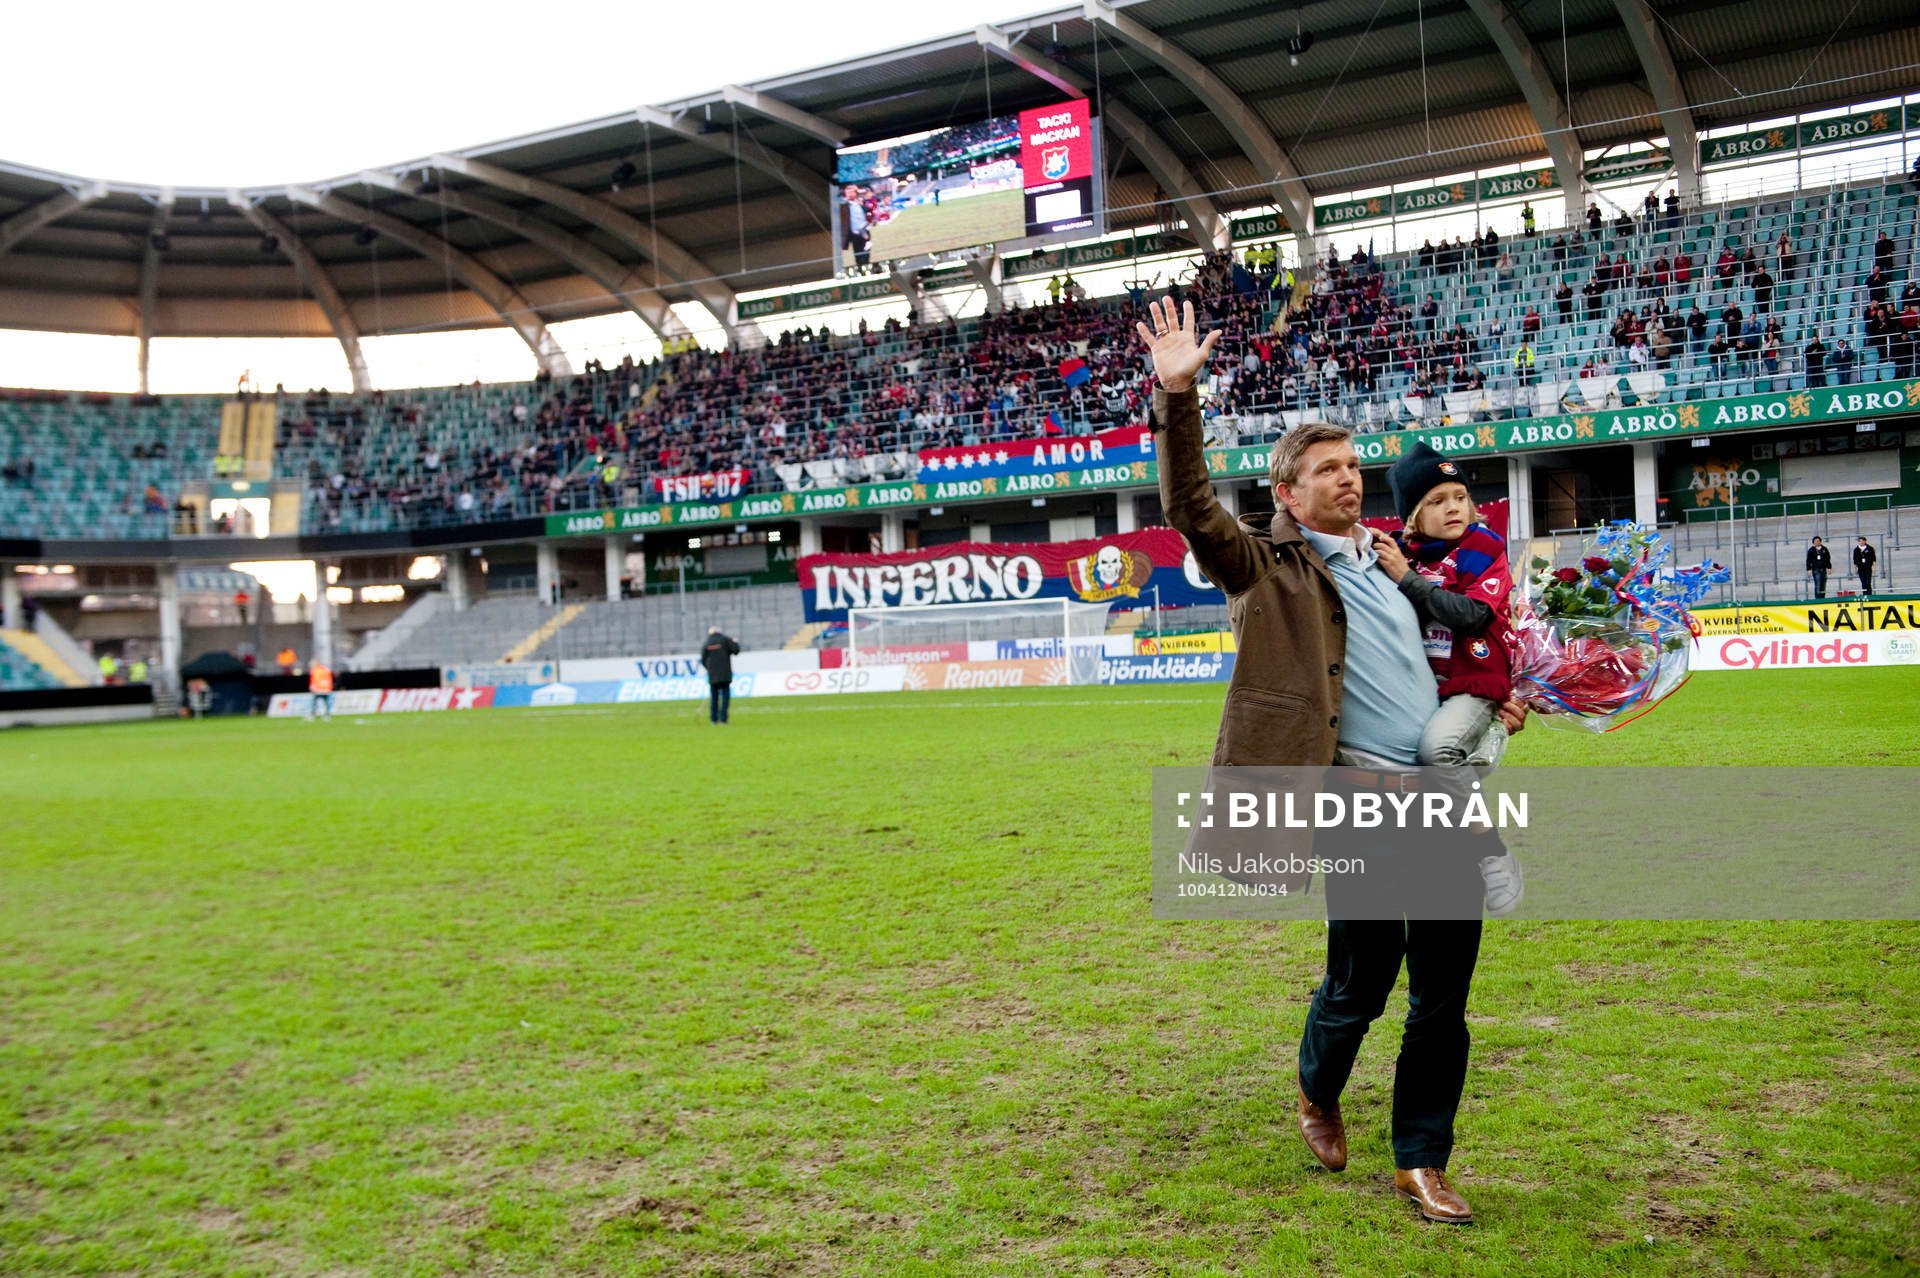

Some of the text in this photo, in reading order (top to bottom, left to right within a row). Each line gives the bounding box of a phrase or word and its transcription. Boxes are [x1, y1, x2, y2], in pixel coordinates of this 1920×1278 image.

[1030, 125, 1080, 146] MACKAN
[1811, 118, 1869, 142] ÅBRO
[1711, 137, 1765, 159] ÅBRO
[1488, 176, 1536, 197] ÅBRO
[1403, 190, 1449, 210] ÅBRO
[1714, 402, 1786, 425] ÅBRO
[1827, 389, 1903, 415] ÅBRO
[1508, 422, 1573, 445] ÅBRO
[1609, 413, 1677, 435] ÅBRO
[1033, 439, 1105, 467] AMOR
[1354, 442, 1382, 459] RO
[662, 475, 700, 503] FSH
[1688, 467, 1760, 490] ÅBRO
[811, 553, 1043, 612] INFERNO
[1704, 614, 1769, 626] KVIBERGS
[1720, 638, 1869, 669] Cylinda
[945, 662, 1023, 688] Renova
[1098, 653, 1222, 685] Björnkläder
